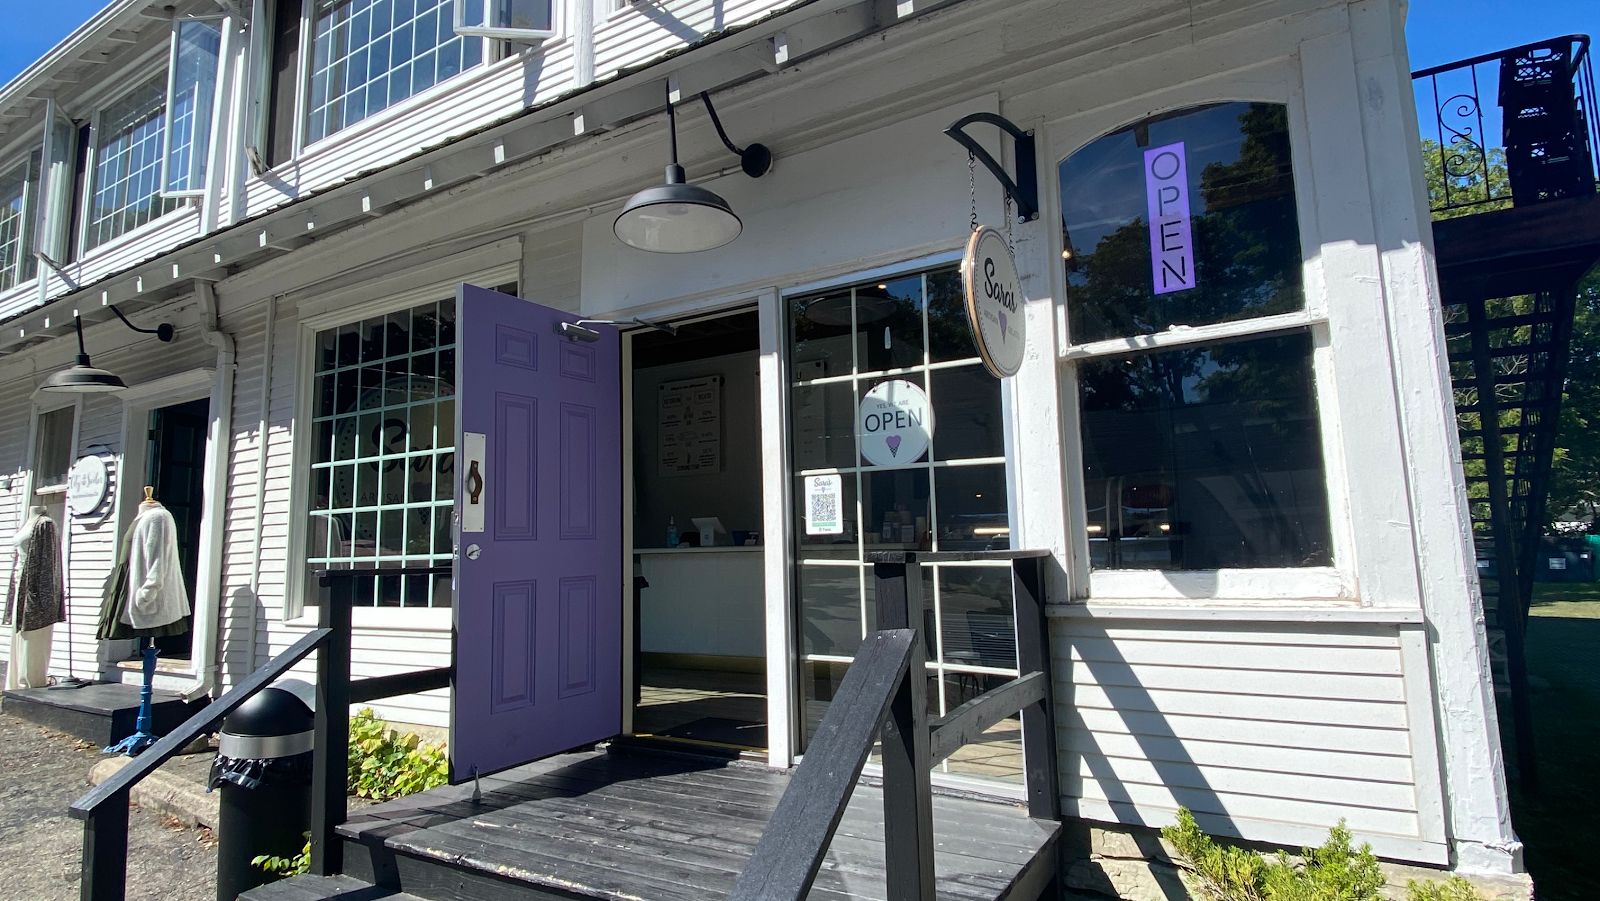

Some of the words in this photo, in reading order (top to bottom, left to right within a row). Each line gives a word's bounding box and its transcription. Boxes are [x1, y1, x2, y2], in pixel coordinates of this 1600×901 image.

[1151, 151, 1186, 288] OPEN
[984, 257, 1017, 314] Sara's
[865, 408, 922, 432] OPEN
